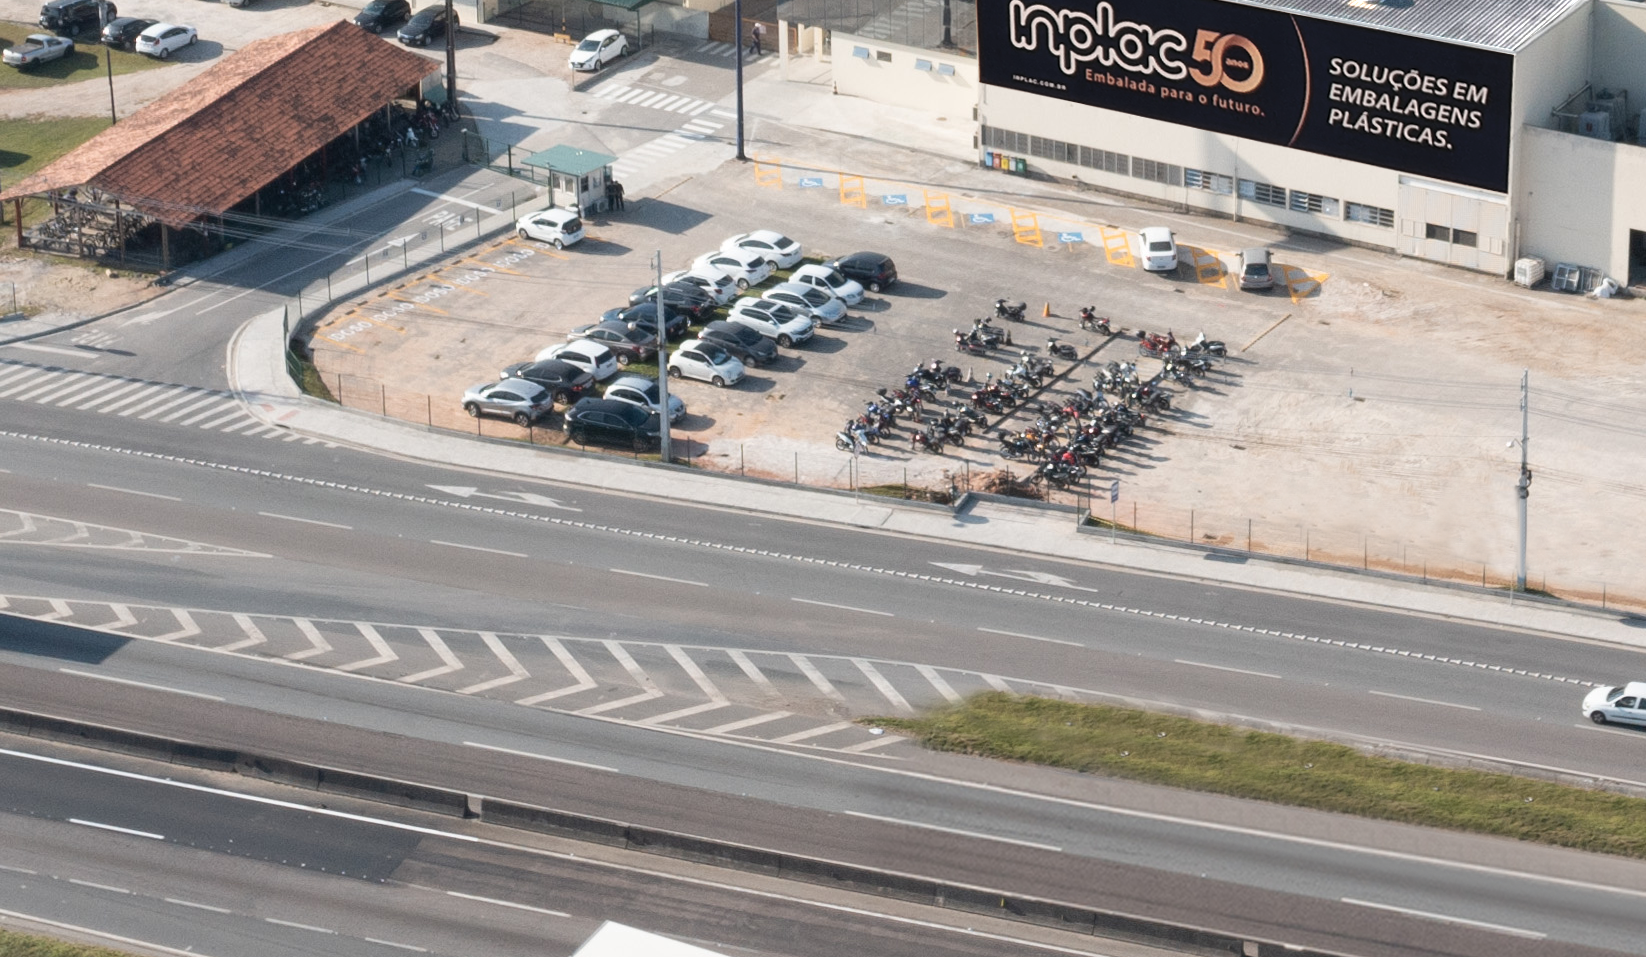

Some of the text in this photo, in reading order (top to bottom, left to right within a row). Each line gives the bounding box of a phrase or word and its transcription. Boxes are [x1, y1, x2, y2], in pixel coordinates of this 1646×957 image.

[1188, 29, 1264, 93] 50
[1225, 57, 1249, 69] anos
[1328, 57, 1489, 105] SOLUÇÕES EM
[1085, 68, 1266, 117] Embalada para o futuro.
[1328, 83, 1483, 129] EMBALAGENS
[1328, 108, 1454, 150] PLÁSTICAS.
